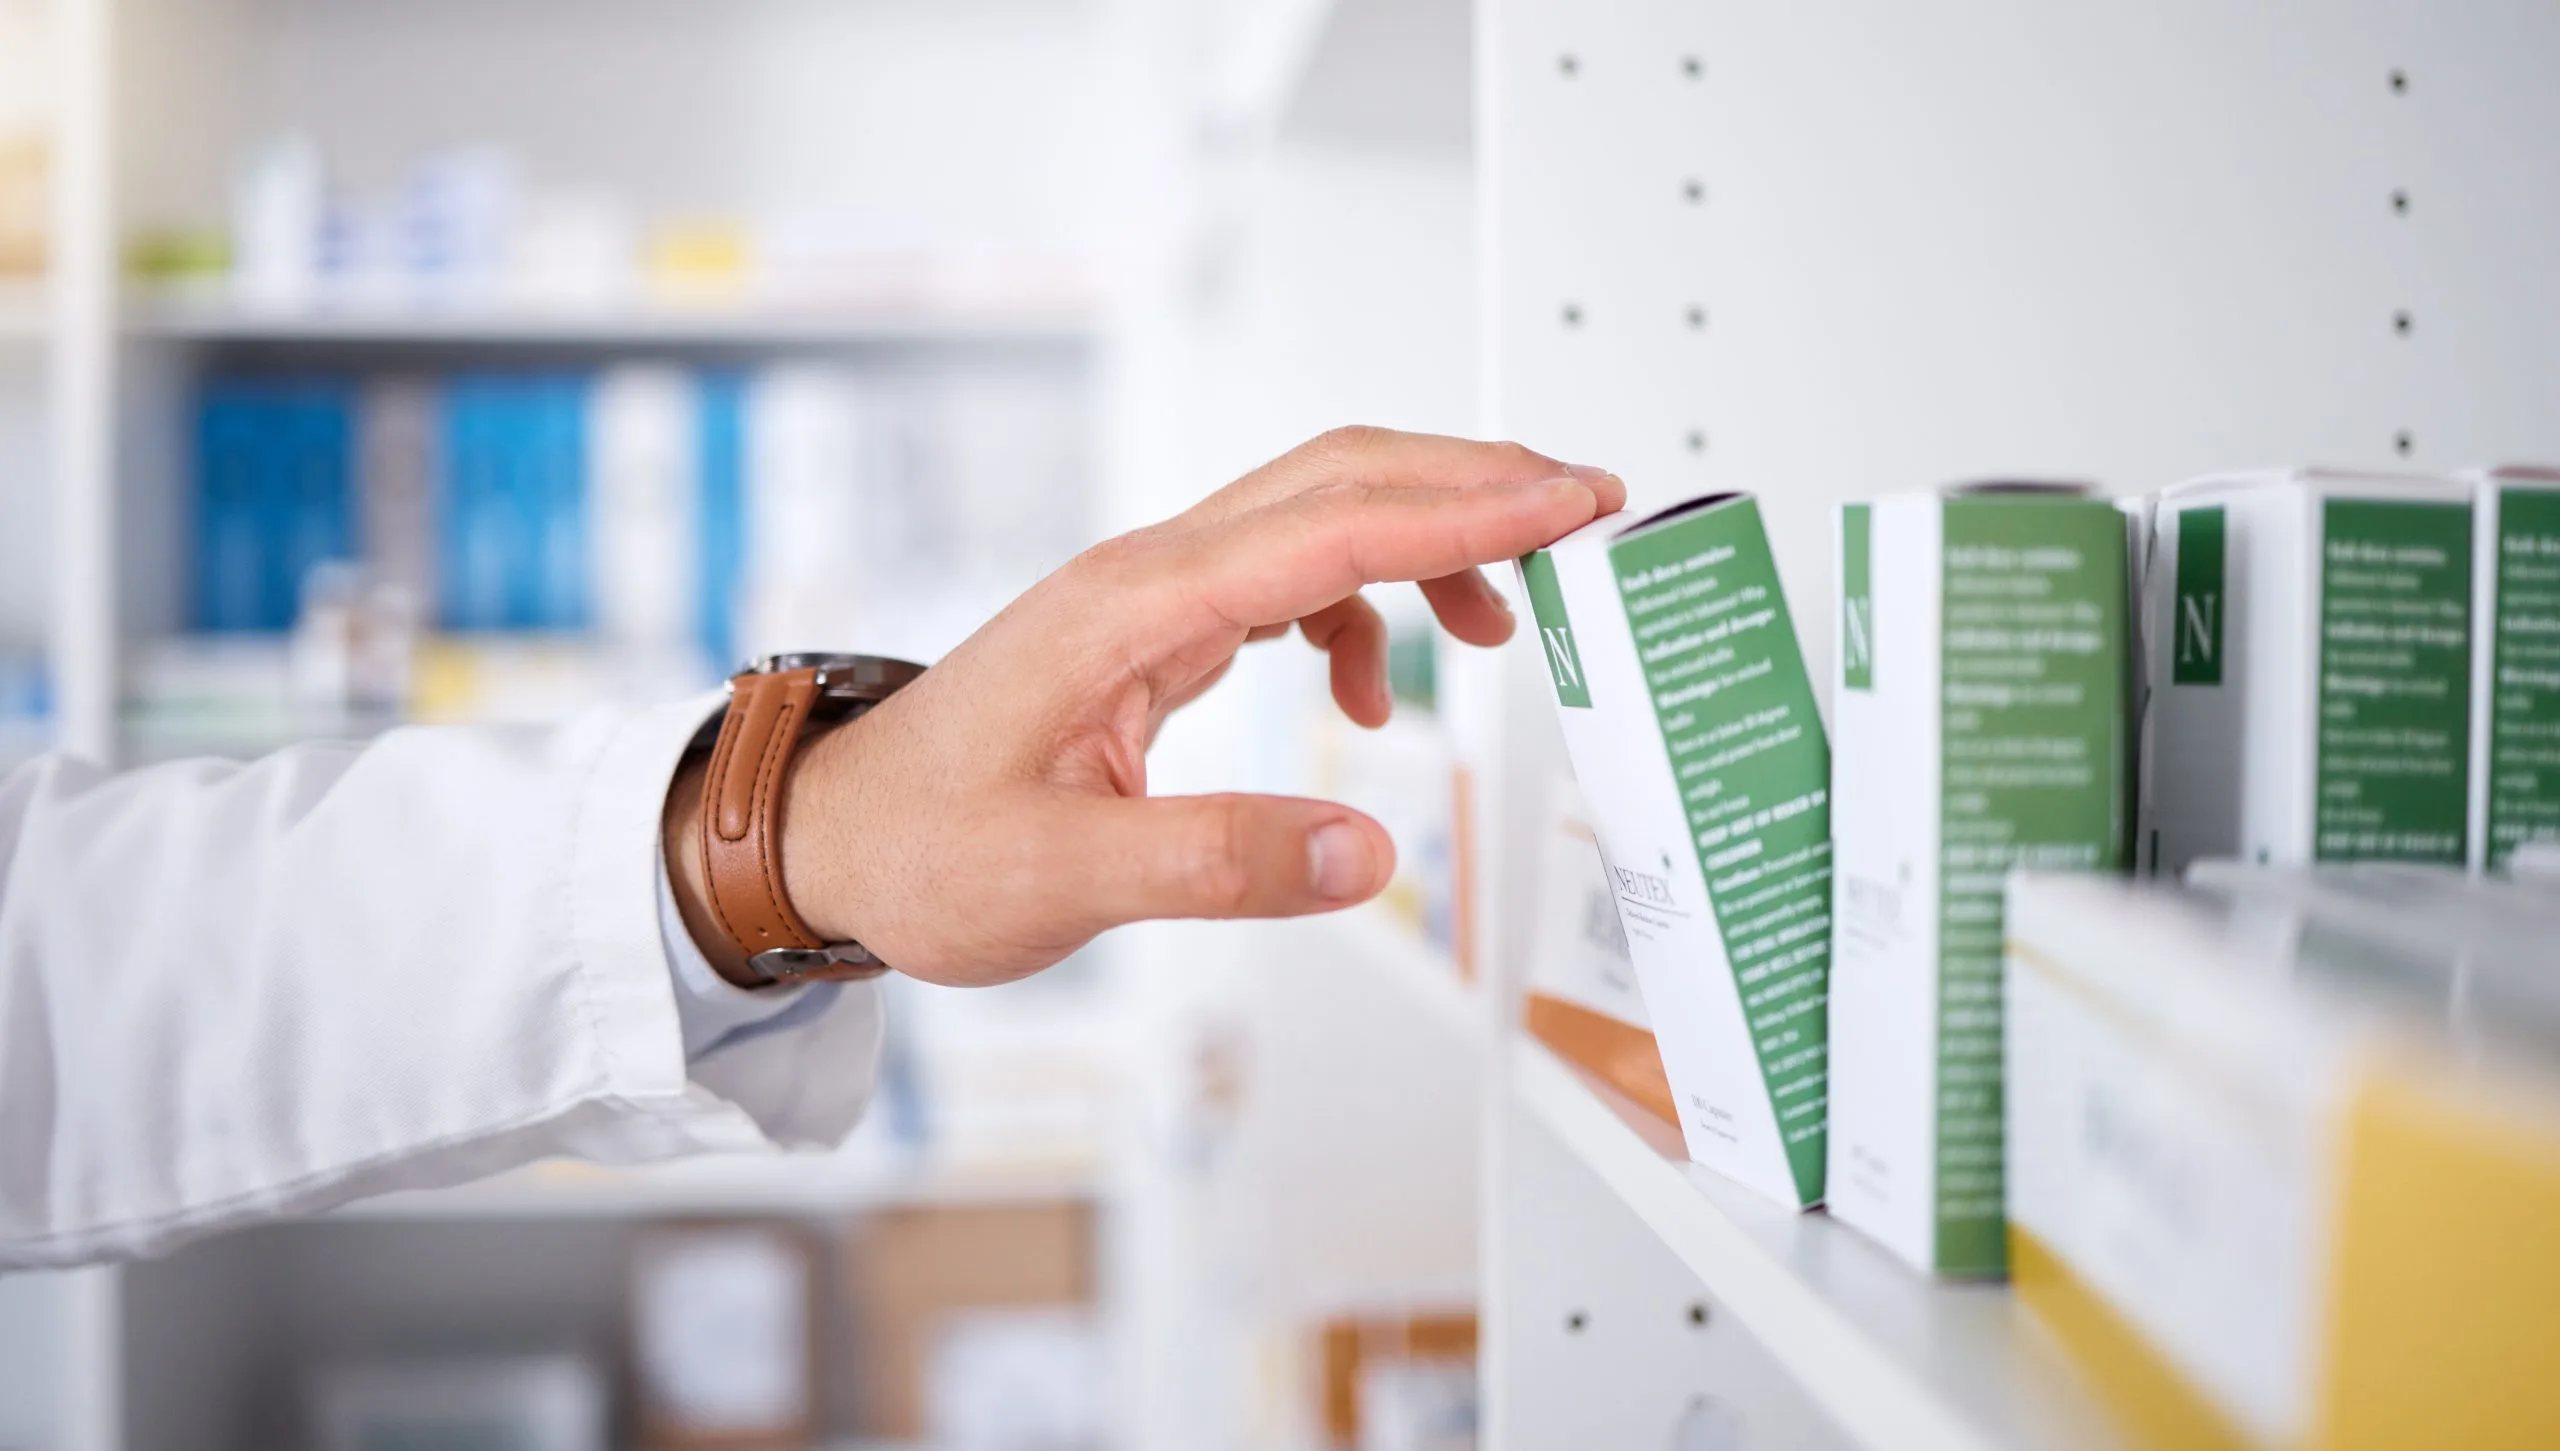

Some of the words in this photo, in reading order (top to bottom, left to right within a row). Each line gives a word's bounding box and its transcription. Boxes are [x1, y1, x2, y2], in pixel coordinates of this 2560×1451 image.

[1543, 627, 1580, 689] N
[2182, 594, 2215, 664] N
[1613, 865, 1676, 906] NEUTEX
